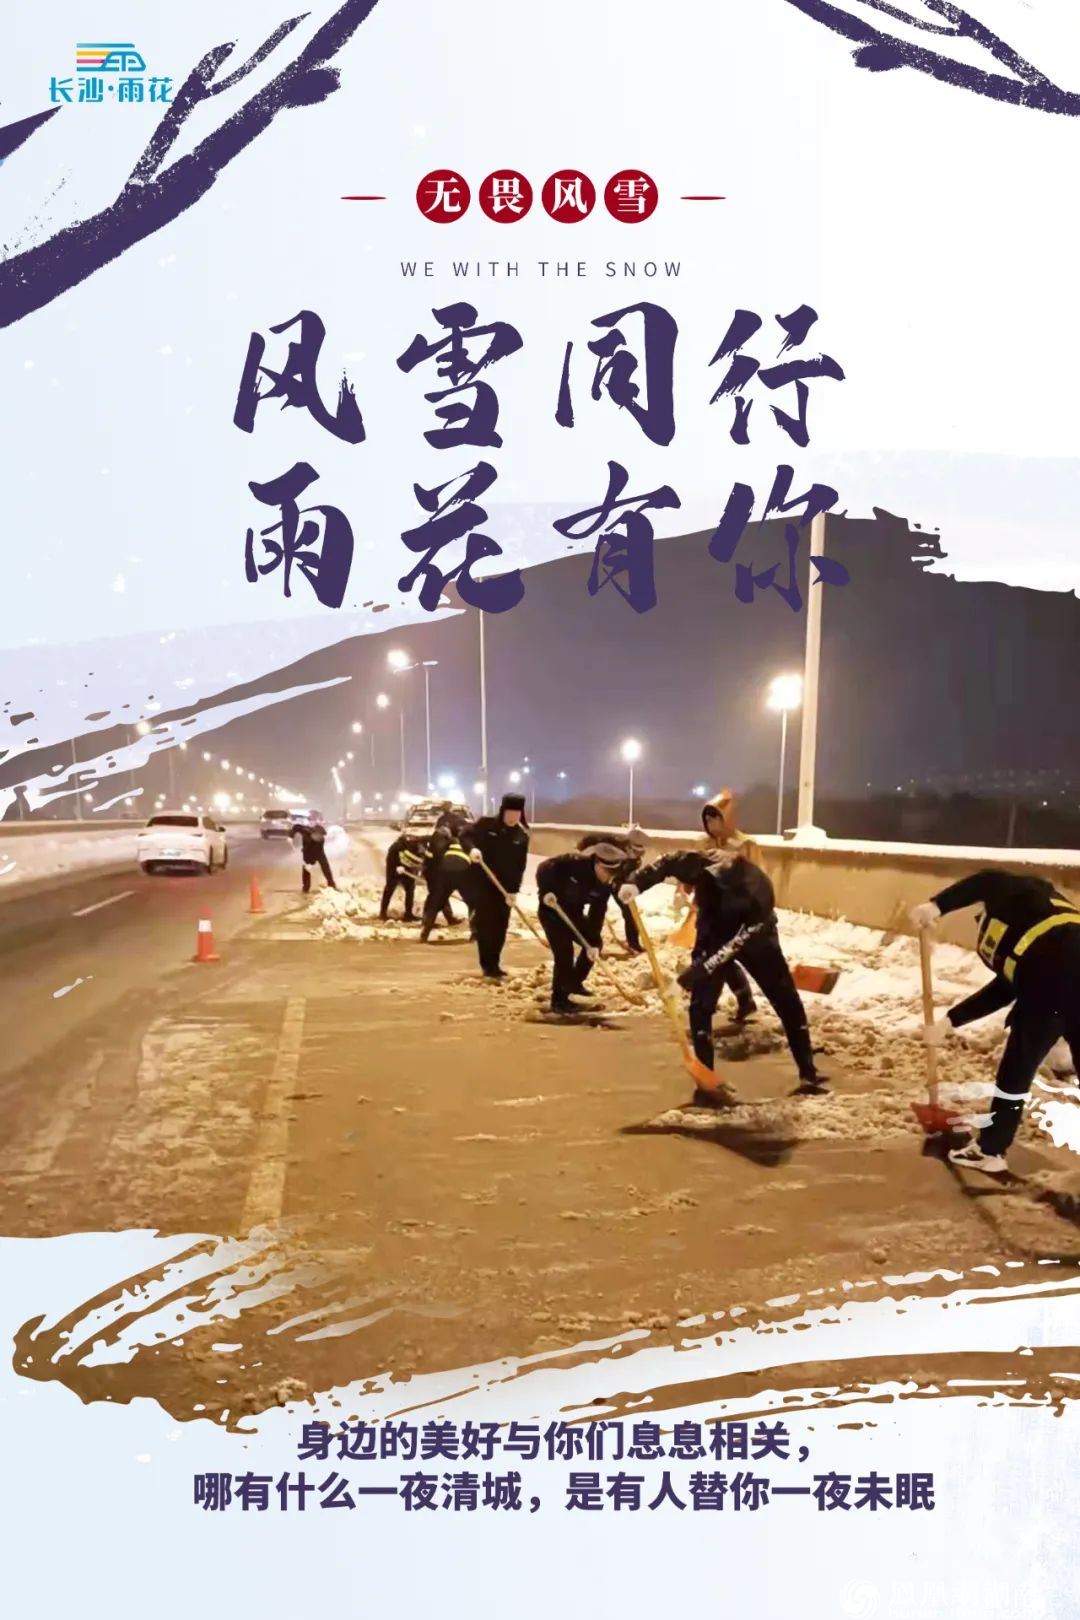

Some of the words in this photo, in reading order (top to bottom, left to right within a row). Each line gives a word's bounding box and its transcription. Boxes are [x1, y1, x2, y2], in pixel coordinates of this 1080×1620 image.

[422, 174, 653, 217] 无畏风雪
[400, 261, 435, 278] WE
[452, 261, 519, 278] WITH
[537, 261, 587, 278] THE
[605, 261, 681, 278] SNOW
[233, 301, 846, 450] 风雪同行
[245, 460, 851, 615] 雨花有你
[297, 1420, 812, 1463] 身边的美好与你们息息相关，
[194, 1471, 935, 1513] 哪有什么一夜清城，是有人替你一夜未眠
